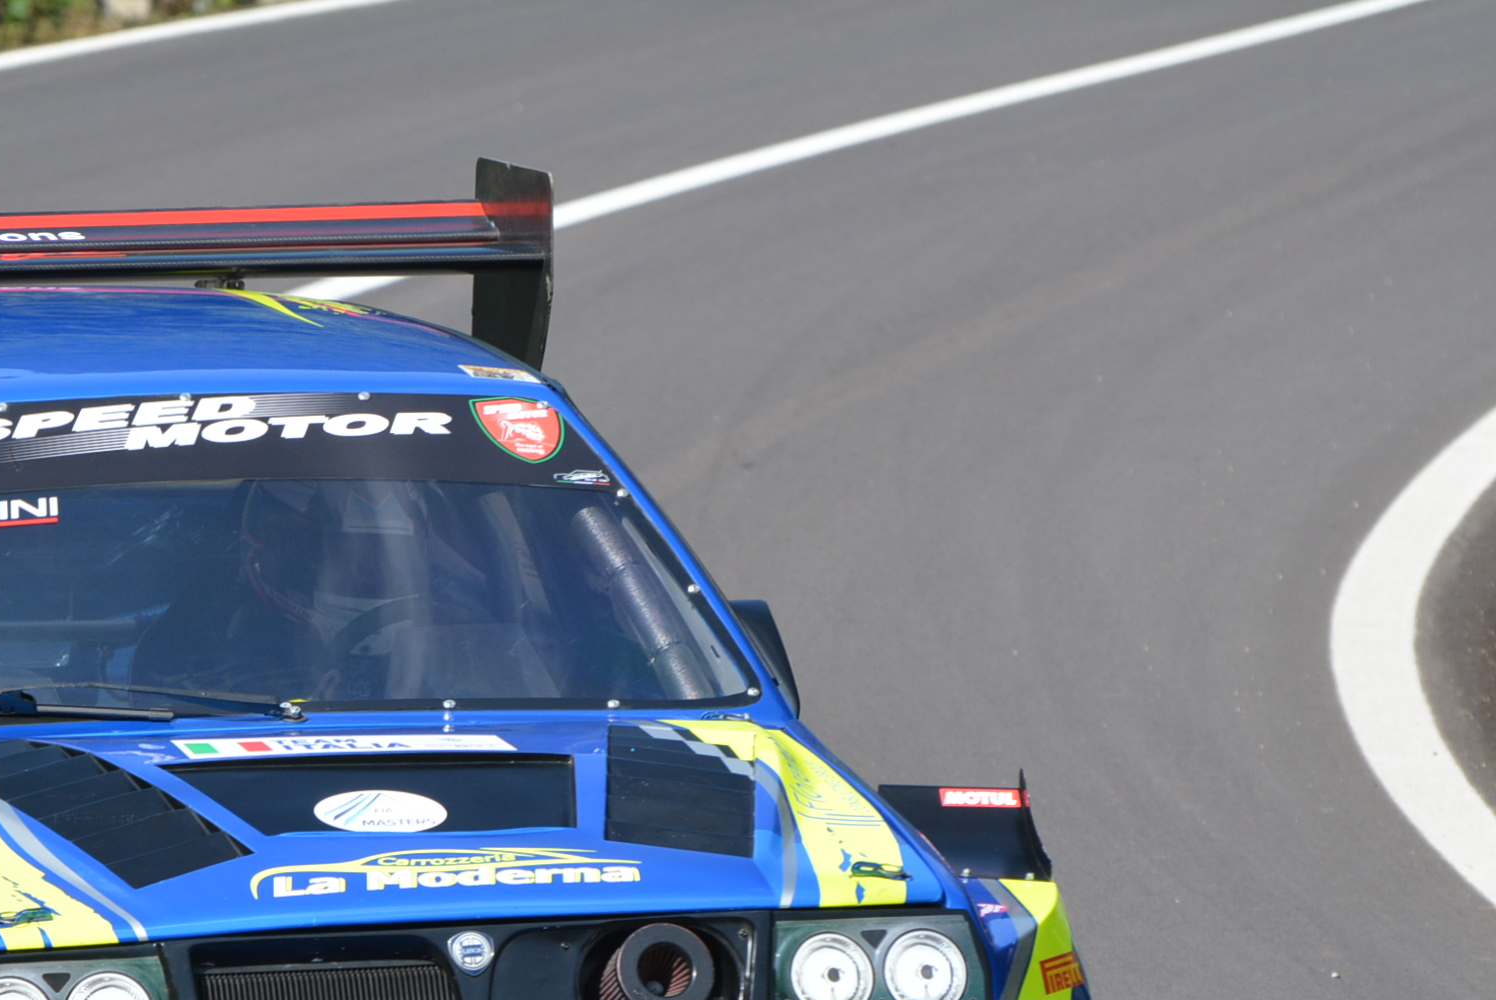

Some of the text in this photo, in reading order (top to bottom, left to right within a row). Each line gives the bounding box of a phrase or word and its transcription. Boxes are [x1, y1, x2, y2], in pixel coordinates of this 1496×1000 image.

[483, 403, 522, 415] SPEED
[507, 409, 548, 420] MOTOR
[125, 412, 452, 450] MOTOR
[944, 791, 1017, 805] MOTUL
[362, 818, 436, 827] MASTERS
[377, 853, 516, 867] Carrozzeria
[273, 865, 641, 898] La Moderna
